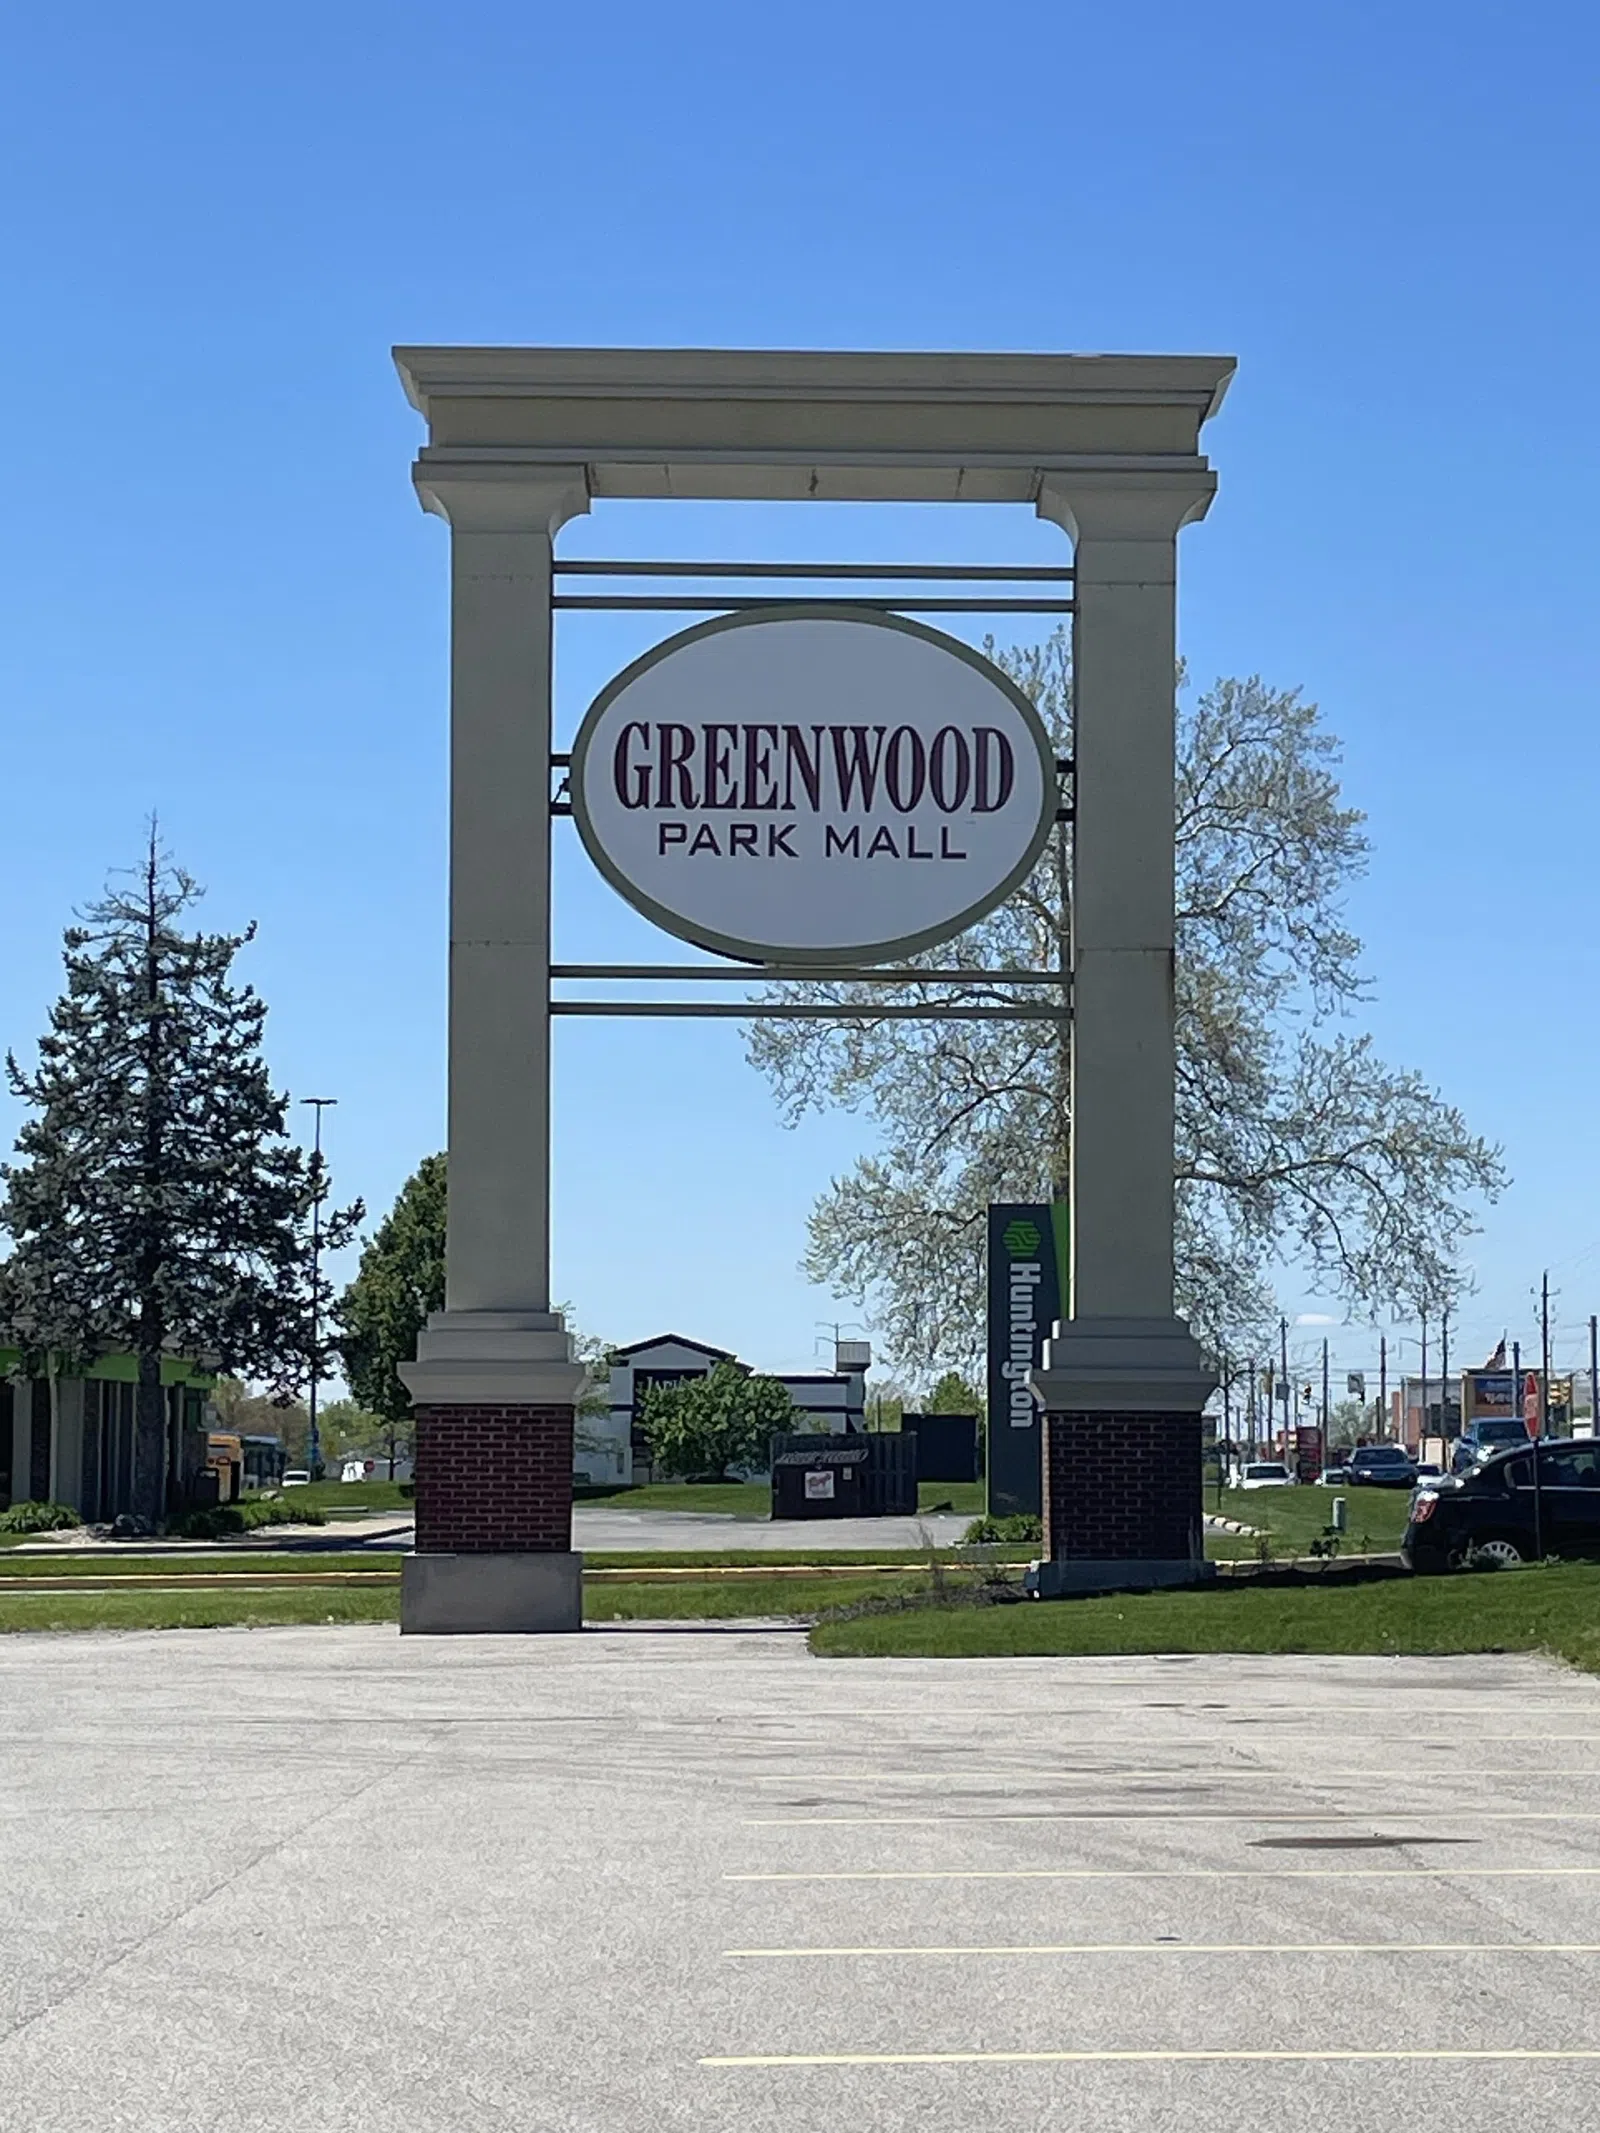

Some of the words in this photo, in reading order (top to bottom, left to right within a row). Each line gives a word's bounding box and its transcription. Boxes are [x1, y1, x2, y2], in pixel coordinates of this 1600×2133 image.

[614, 722, 1014, 813] GREENWOOD
[659, 823, 799, 857] PARK
[826, 825, 967, 860] MALL
